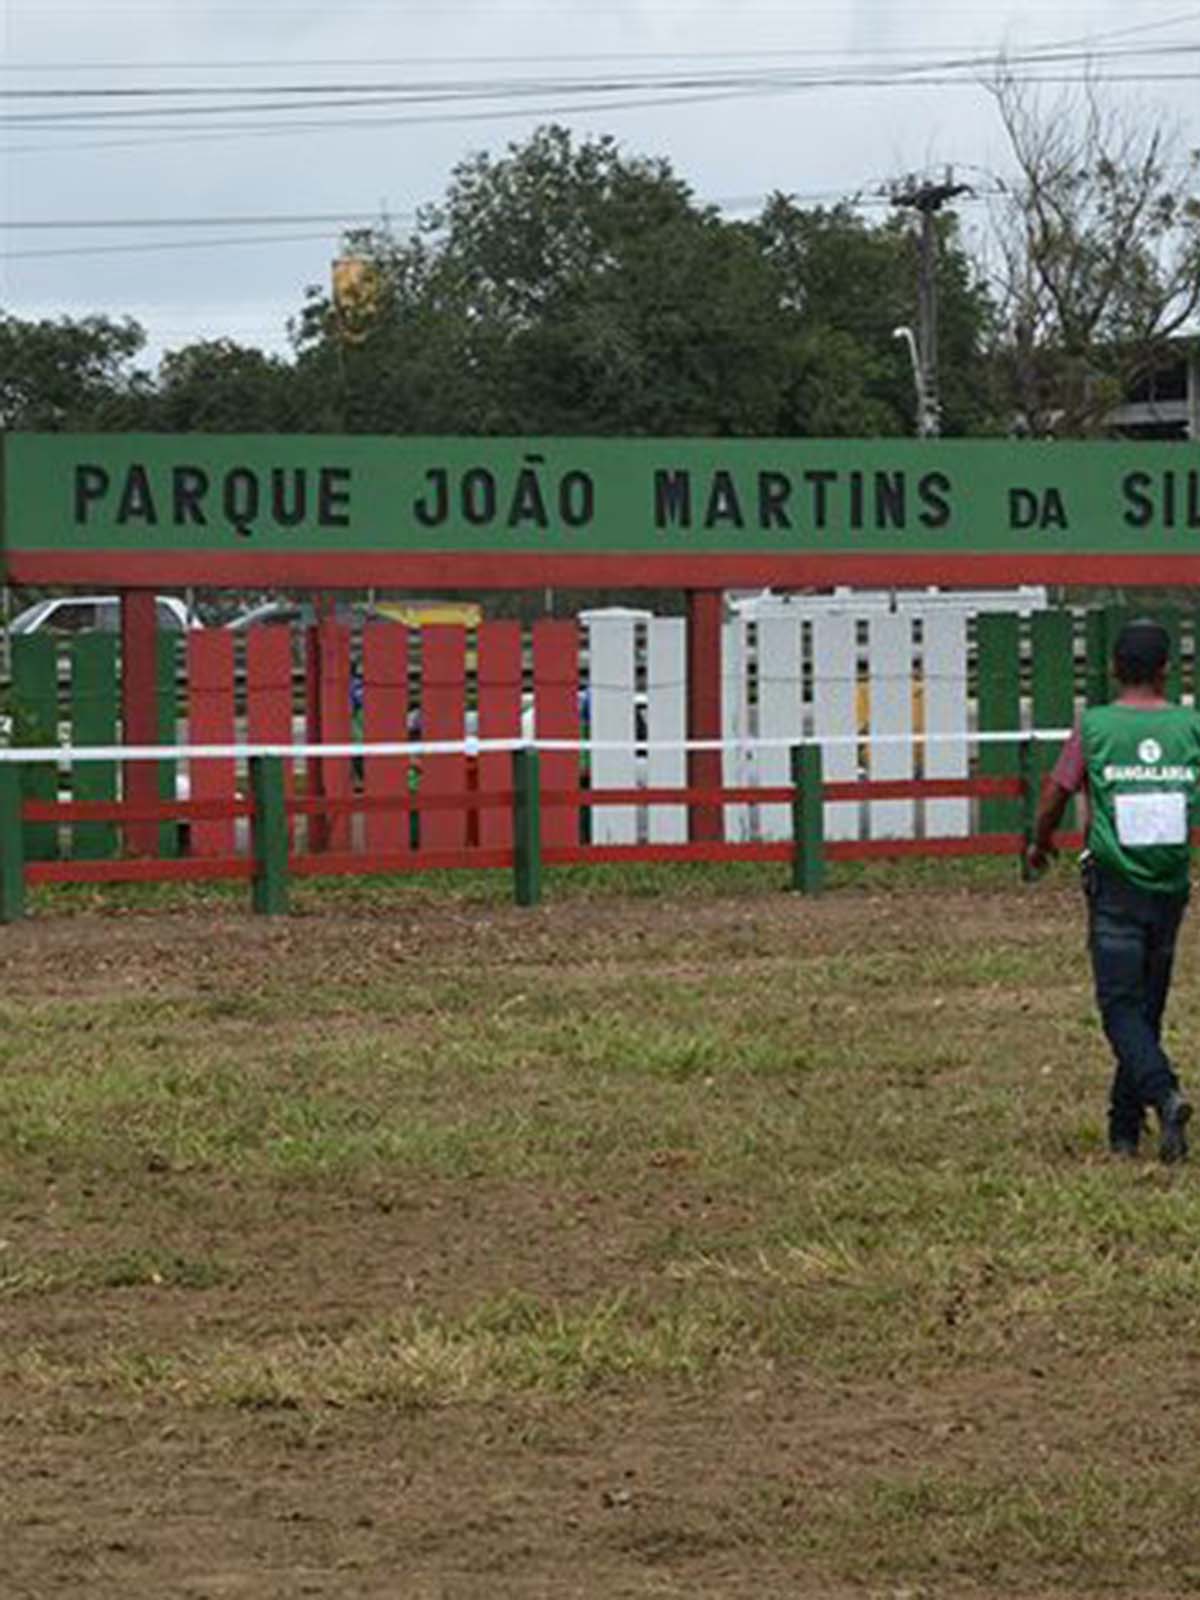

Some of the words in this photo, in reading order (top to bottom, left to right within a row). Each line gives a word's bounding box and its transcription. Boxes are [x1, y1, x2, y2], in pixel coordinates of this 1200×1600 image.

[73, 464, 352, 536] PARQUE
[413, 453, 595, 528] JOÃO
[653, 469, 952, 530] MARTINS
[1008, 487, 1069, 530] DA
